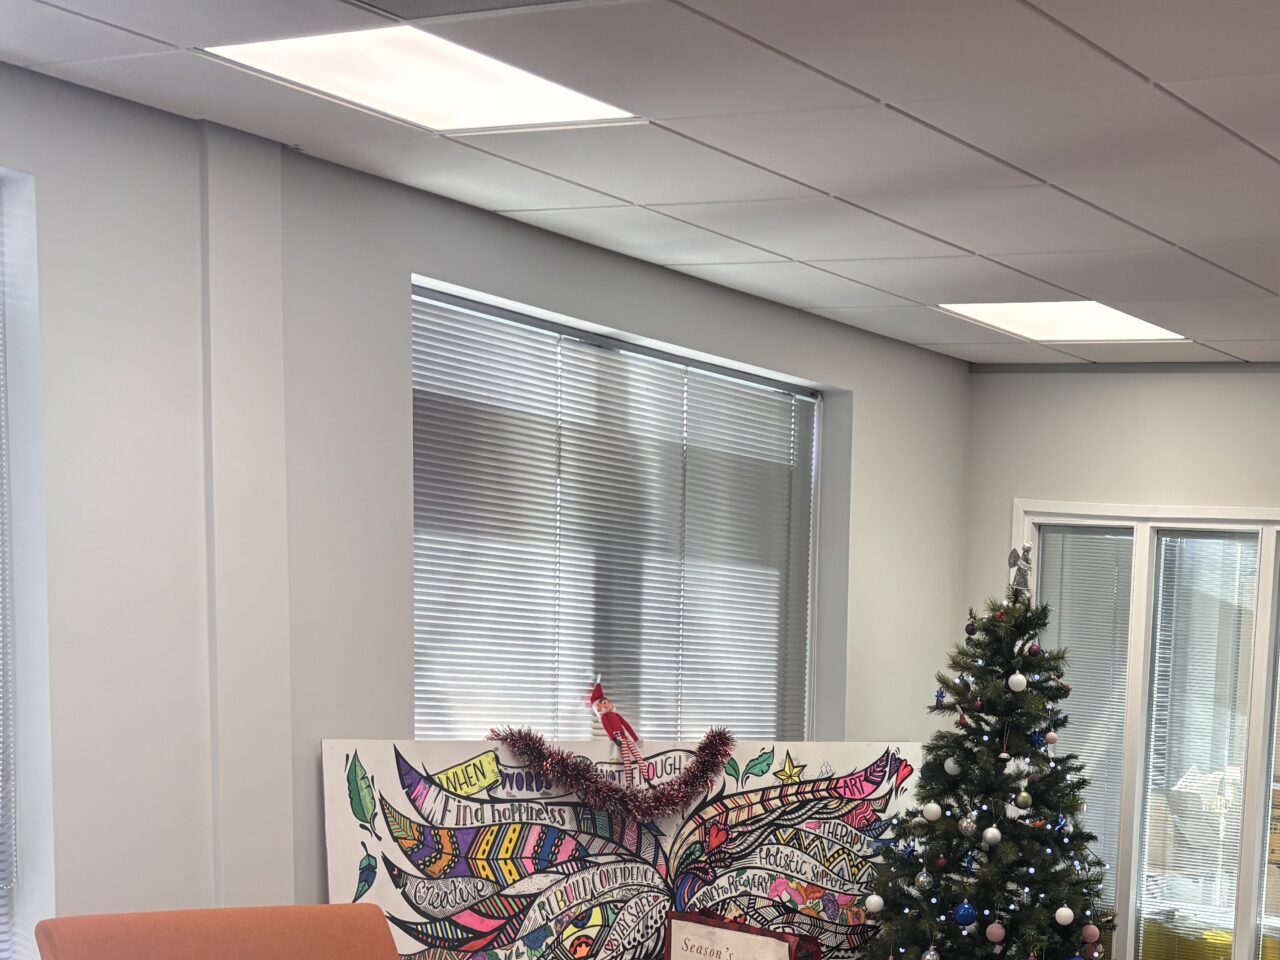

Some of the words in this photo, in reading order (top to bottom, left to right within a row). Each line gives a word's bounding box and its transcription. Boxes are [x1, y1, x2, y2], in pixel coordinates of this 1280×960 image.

[437, 759, 488, 793] WHEN
[841, 775, 864, 797] ART
[437, 793, 486, 827] Find
[490, 800, 567, 827] happiness
[821, 820, 867, 851] THERAPY
[414, 879, 489, 910] Creative
[591, 864, 657, 894] CONFIDENCE
[609, 913, 632, 945] STAY
[626, 893, 653, 924] SAFE
